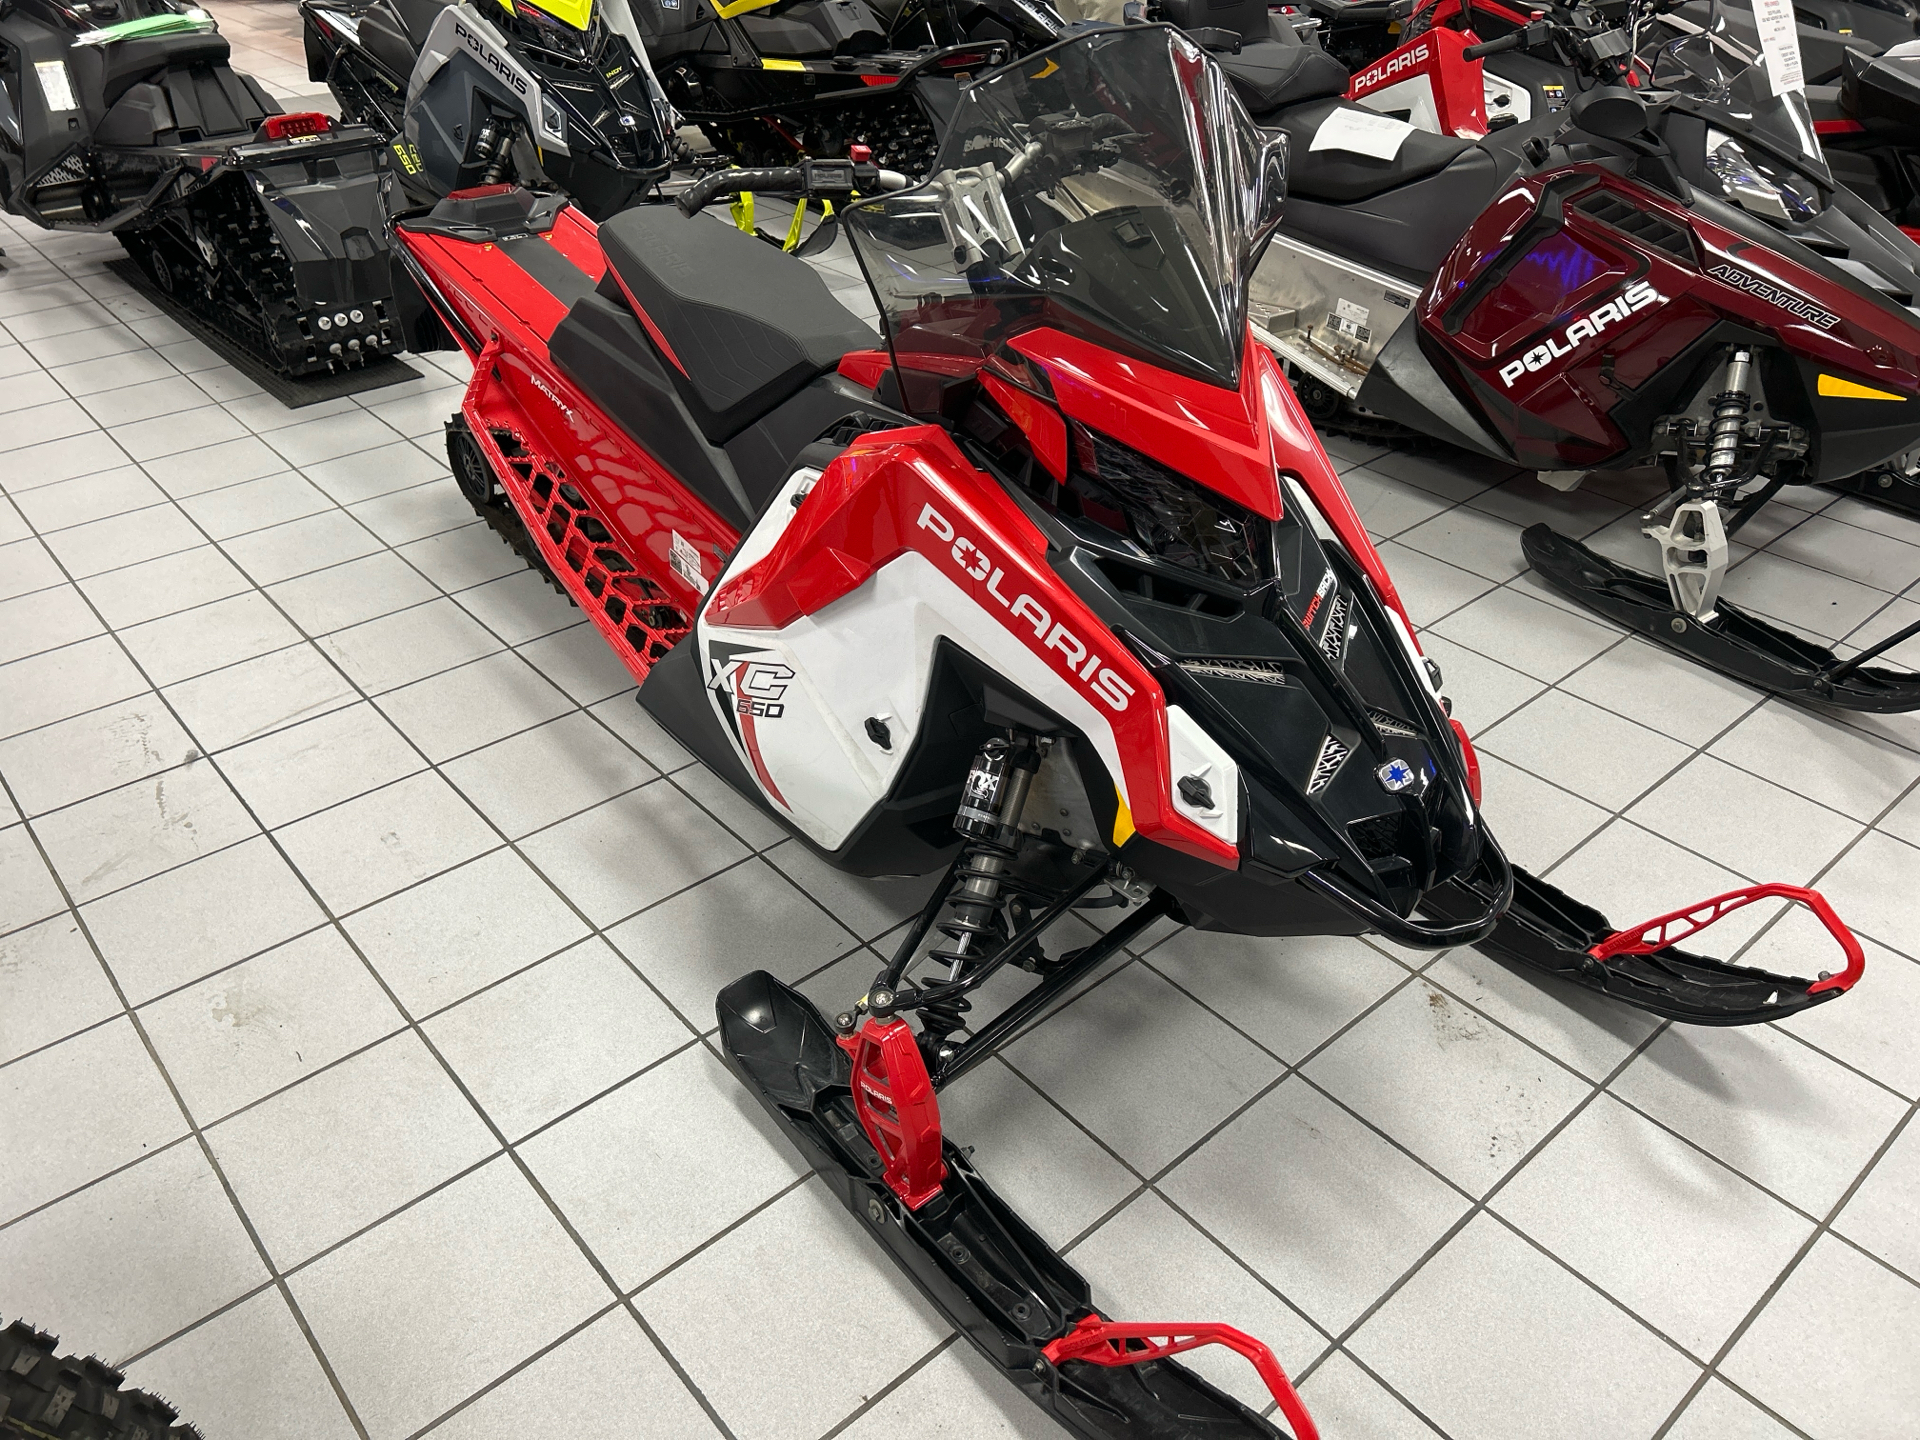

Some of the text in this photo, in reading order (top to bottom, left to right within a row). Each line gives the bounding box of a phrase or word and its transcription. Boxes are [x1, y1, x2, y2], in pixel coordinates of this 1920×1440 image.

[455, 22, 528, 95] POLARIS
[605, 65, 623, 79] INDY
[1354, 43, 1430, 93] POLARIS
[392, 143, 417, 176] 650
[1706, 263, 1842, 330] ADVENTURE
[1498, 280, 1660, 389] POLARIS
[530, 374, 575, 424] MATRYX
[916, 502, 1136, 712] POLARIS
[1301, 566, 1336, 632] SWITCHBACK
[706, 658, 796, 701] XC
[736, 698, 785, 719] 650
[860, 1080, 893, 1105] POLARIS
